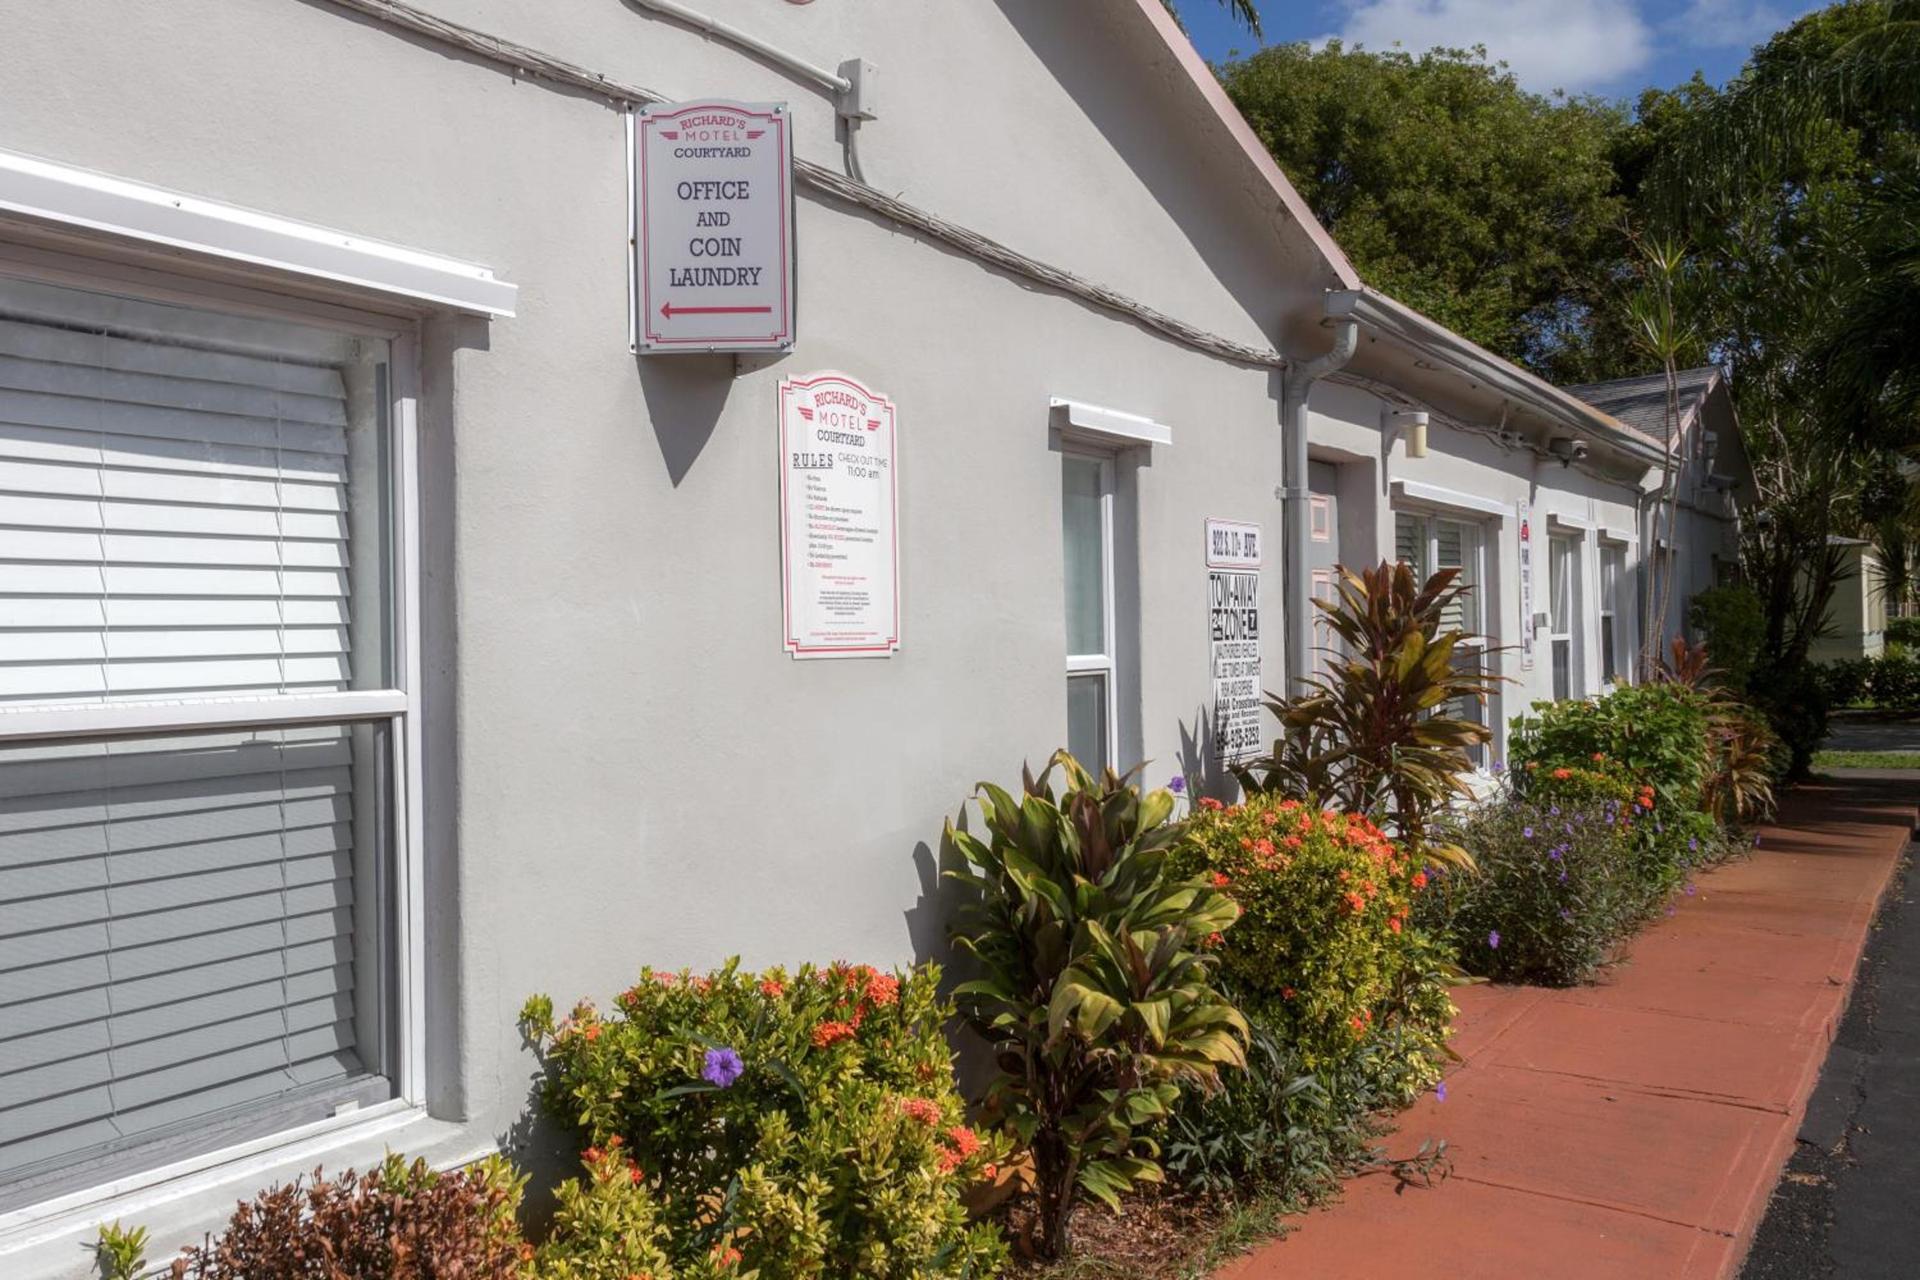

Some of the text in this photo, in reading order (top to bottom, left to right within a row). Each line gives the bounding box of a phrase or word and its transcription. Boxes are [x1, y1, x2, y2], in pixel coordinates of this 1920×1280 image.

[679, 114, 747, 131] RICHARD'S
[685, 130, 741, 142] MOTEL
[673, 146, 752, 159] COURTYARD
[676, 180, 750, 201] OFFICE
[695, 211, 731, 227] AND
[689, 237, 742, 257] COIN
[669, 266, 763, 288] LAUNDRY
[814, 390, 868, 417] RICHARD'S
[819, 410, 863, 431] MOTEL
[816, 428, 865, 447] COURTYARD
[792, 452, 834, 468] RULES
[1209, 574, 1259, 608] TOW-AWAY
[1223, 608, 1247, 641] ZONE
